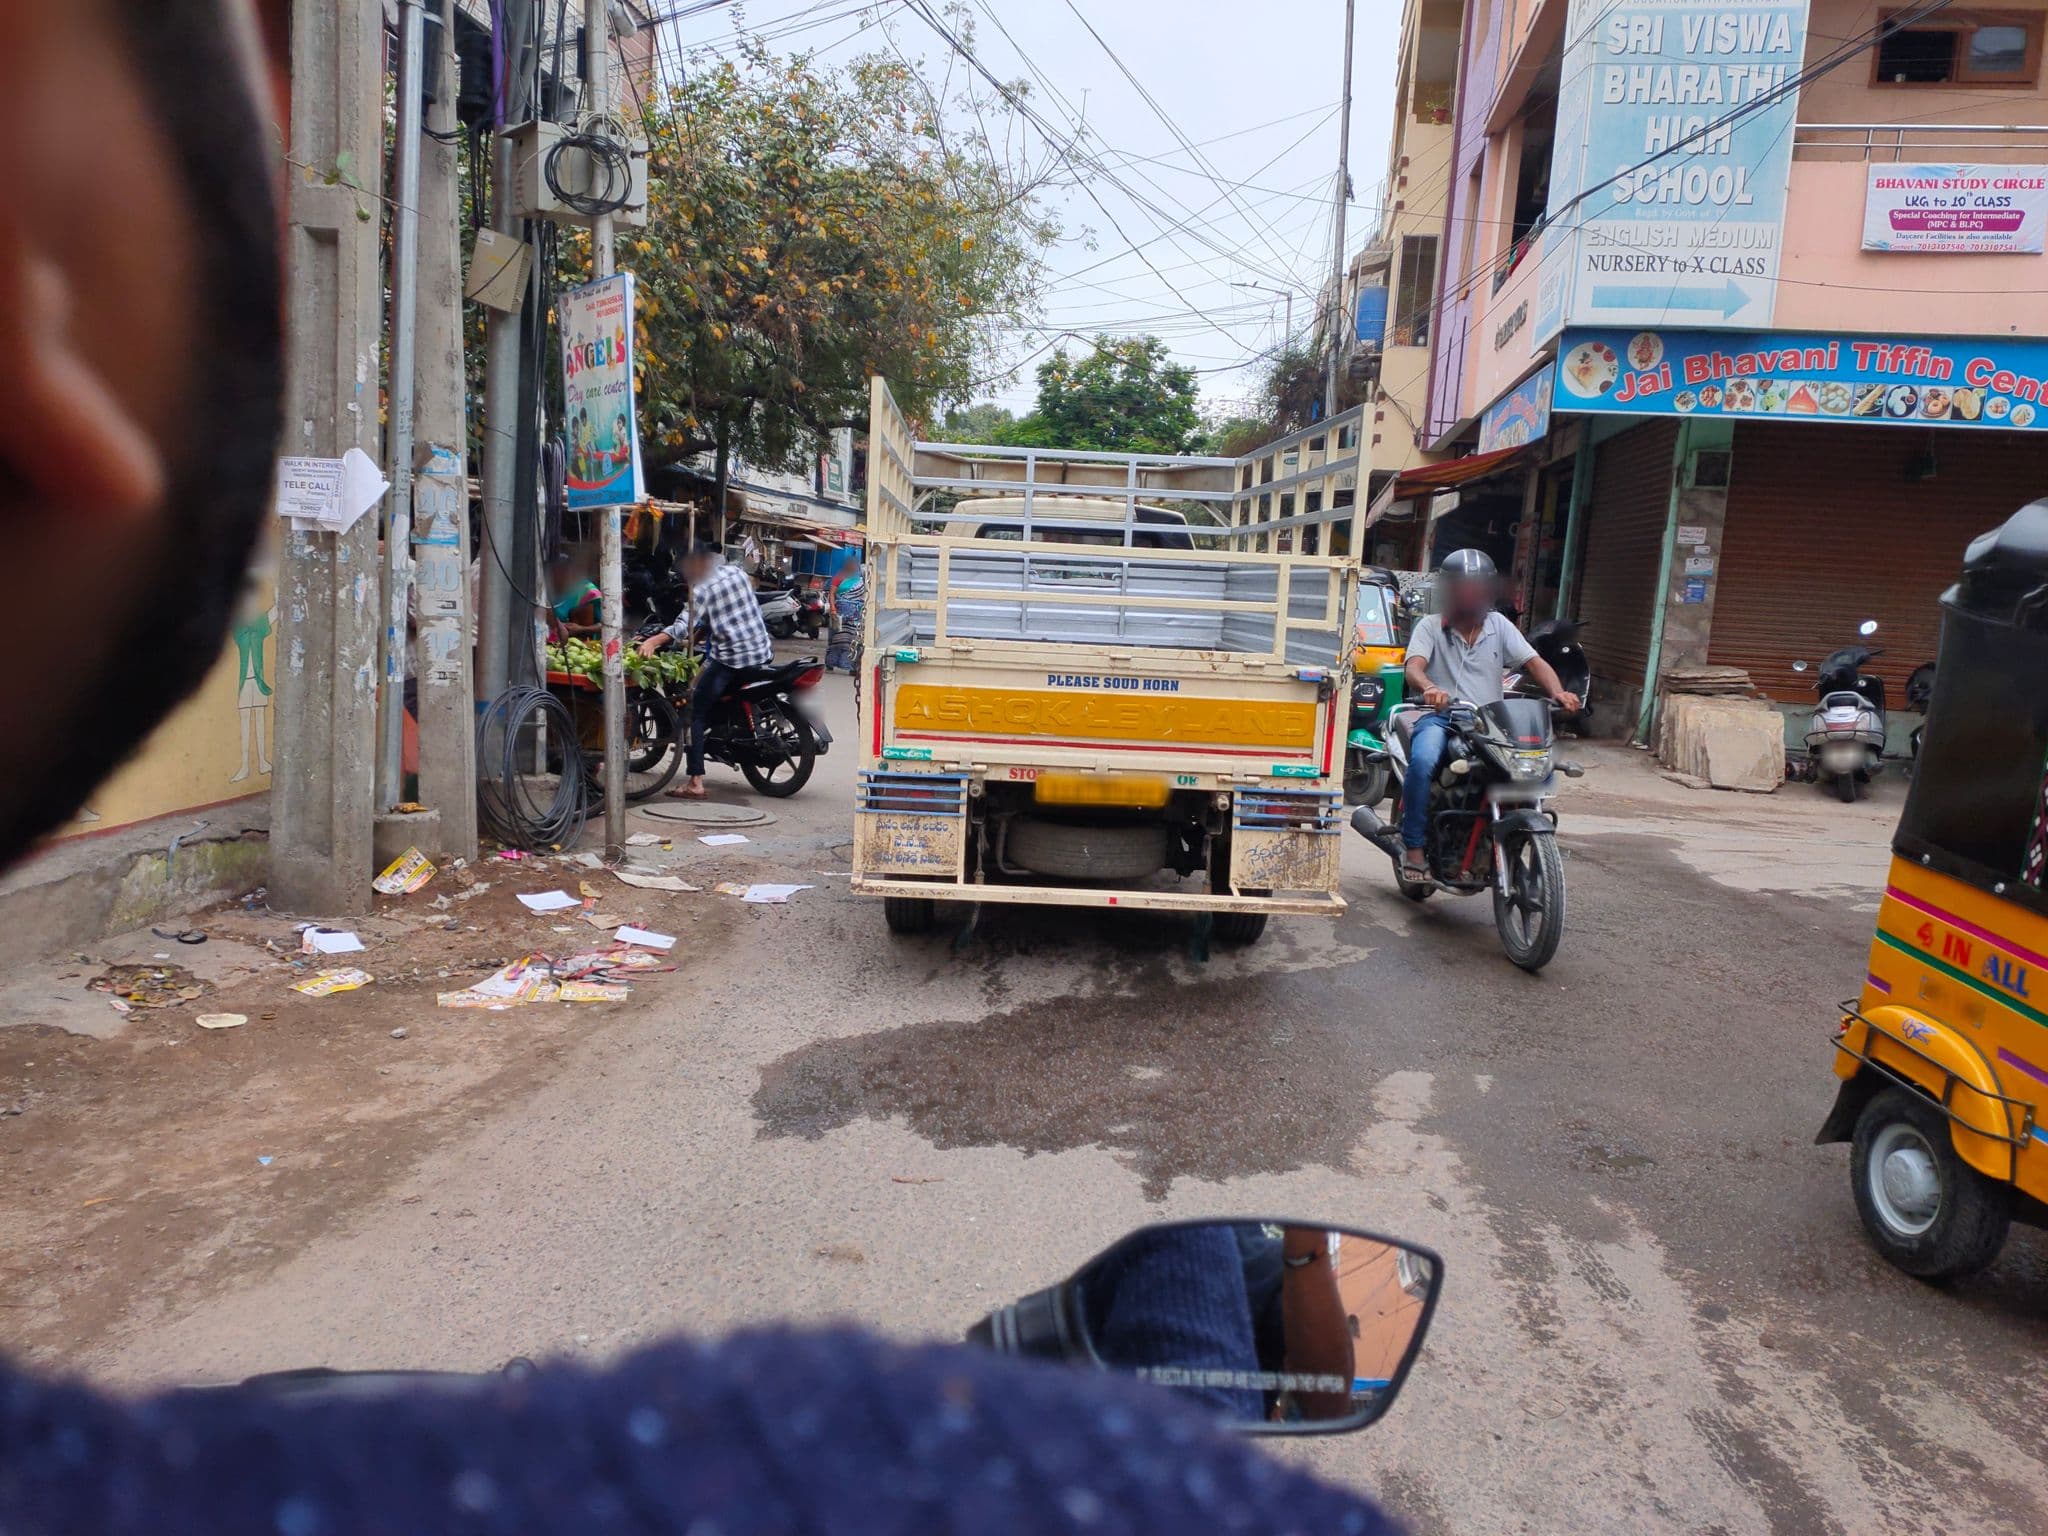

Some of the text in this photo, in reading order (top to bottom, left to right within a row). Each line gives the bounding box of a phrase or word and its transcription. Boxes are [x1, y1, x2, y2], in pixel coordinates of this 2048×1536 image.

[1607, 13, 1793, 55] SRI VISWA
[1604, 64, 1788, 105] BHARATHI
[1644, 114, 1734, 155] HIGH
[1612, 163, 1754, 206] SCHOOL
[1875, 178, 2046, 190] BHAVANI STUDY CIRCLE
[1905, 196, 1929, 208] LKG
[1934, 196, 1947, 207] to
[1974, 196, 2012, 208] CLASS
[1893, 211, 2021, 221] Special Coaching for Intermediate
[1927, 220, 1948, 230] (MPC
[1587, 222, 1776, 249] ENGLISH MEDIUM
[1896, 232, 1924, 241] Daycare
[1966, 232, 1981, 240] also
[1982, 232, 2013, 241] available
[1587, 254, 1766, 275] NURSERY to X CLASS
[566, 332, 626, 379] ANGELS
[1615, 361, 1673, 402] Jai
[1683, 340, 1839, 386] Bhavani
[1852, 341, 1953, 381] Tiffin
[568, 378, 627, 404] Day care center
[284, 480, 306, 489] TELE
[1048, 674, 1180, 692] PLEASE SOUD HORN
[901, 693, 1306, 737] ASHOK LEYLAND
[1916, 921, 2028, 997] 4 IN ALL
